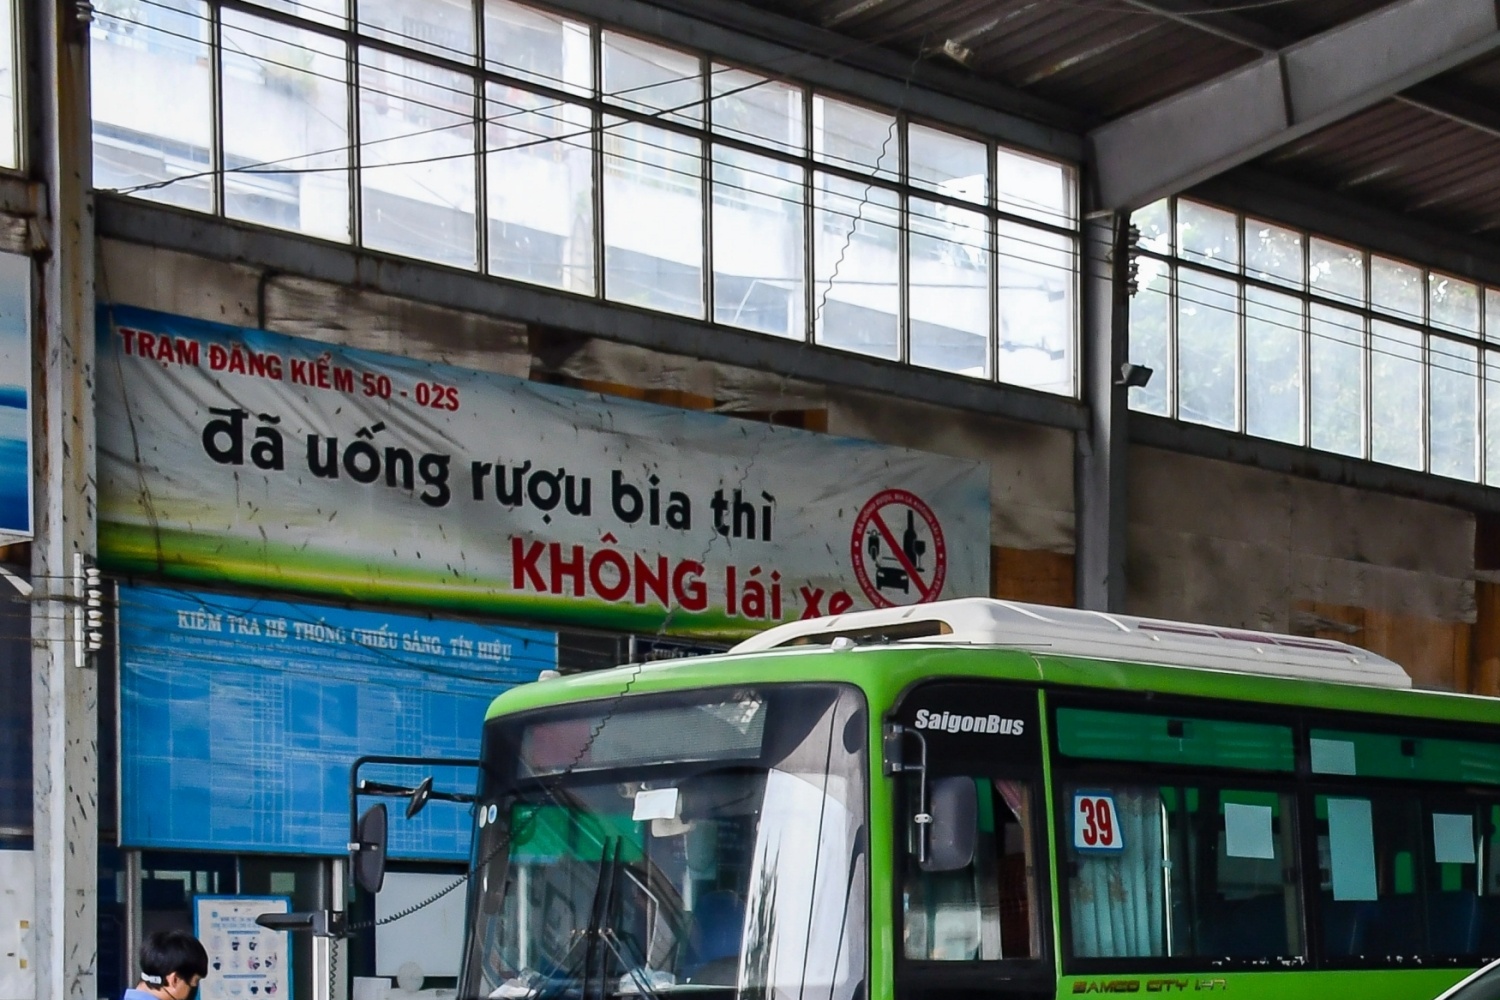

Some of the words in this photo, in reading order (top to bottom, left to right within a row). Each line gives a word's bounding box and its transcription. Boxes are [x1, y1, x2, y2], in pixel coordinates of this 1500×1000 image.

[119, 328, 200, 368] TRẠM
[209, 342, 283, 381] ĐĂNG
[290, 352, 354, 394] KIỂM
[362, 372, 392, 400] 50
[400, 390, 408, 398] -
[415, 382, 460, 412] 02S
[202, 407, 285, 471] đã
[307, 421, 451, 507] uống
[471, 460, 591, 525] rượu
[611, 470, 691, 531] bia
[710, 489, 776, 542] thì
[512, 532, 708, 612] KHÔNG
[726, 565, 782, 620] lái
[799, 586, 854, 620] xe
[228, 614, 261, 636] TRA
[265, 617, 288, 643] HỆ
[293, 616, 346, 645] THỐNG
[352, 623, 399, 650] CHIẾU
[450, 634, 474, 657] TÍN
[477, 638, 513, 664] HIỆU
[914, 708, 1025, 736] SaigonBus
[1079, 797, 1114, 847] 39
